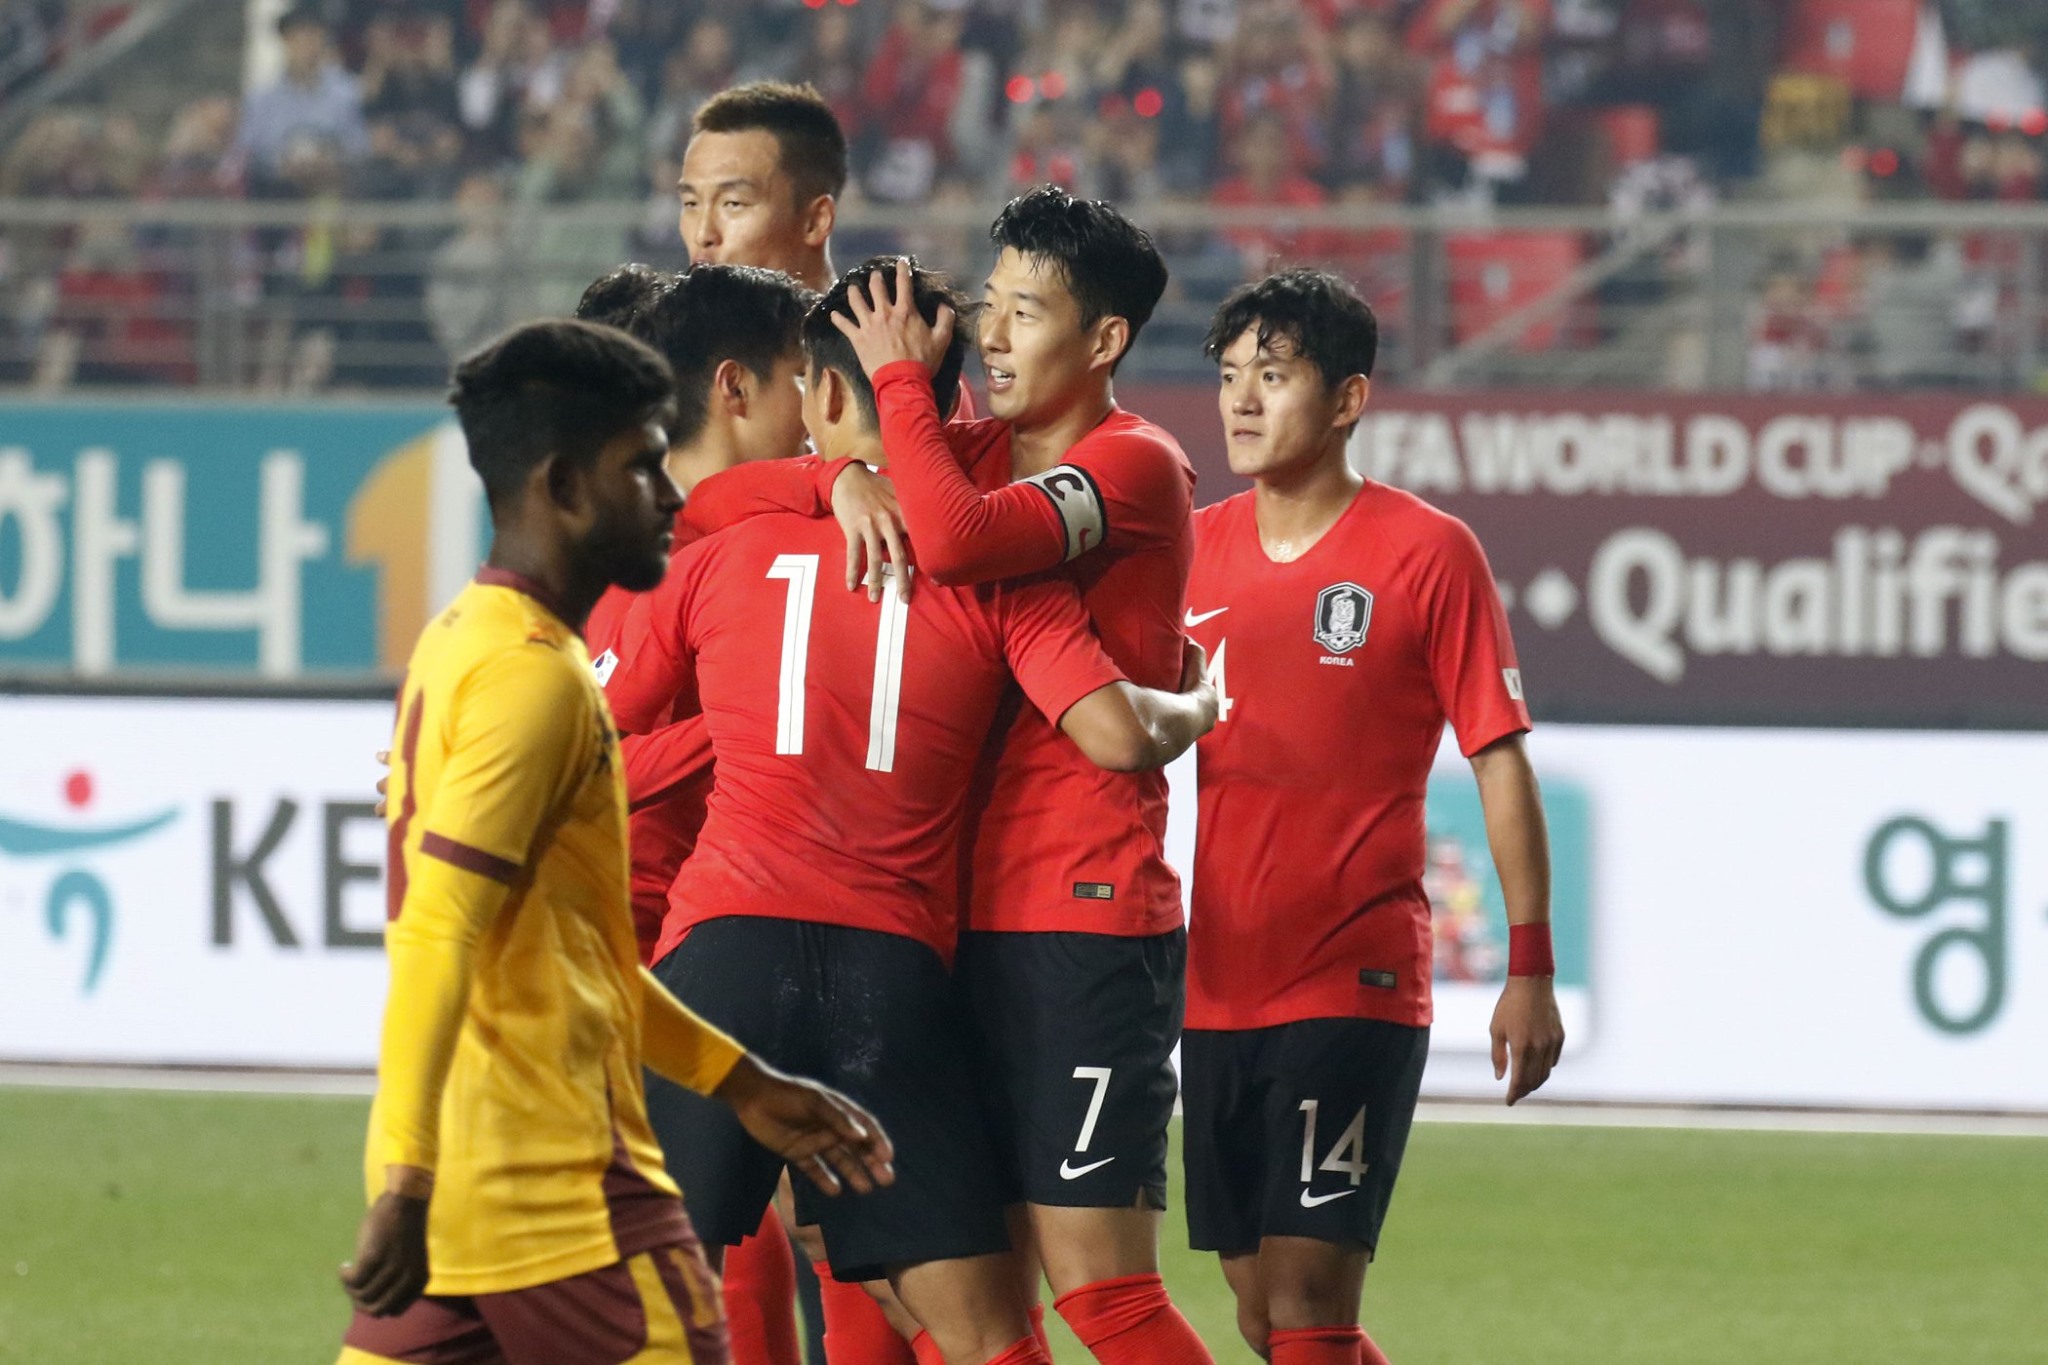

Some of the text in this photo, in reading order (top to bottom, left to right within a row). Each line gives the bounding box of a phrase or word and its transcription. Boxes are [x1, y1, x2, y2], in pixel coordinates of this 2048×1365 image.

[1043, 473, 1084, 501] C
[1461, 411, 1752, 497] WORLD
[1756, 414, 1914, 500] CUP
[766, 554, 914, 773] 11
[1319, 656, 1355, 667] KOREA
[1072, 1066, 1113, 1153] 7
[1299, 1099, 1370, 1187] 14
